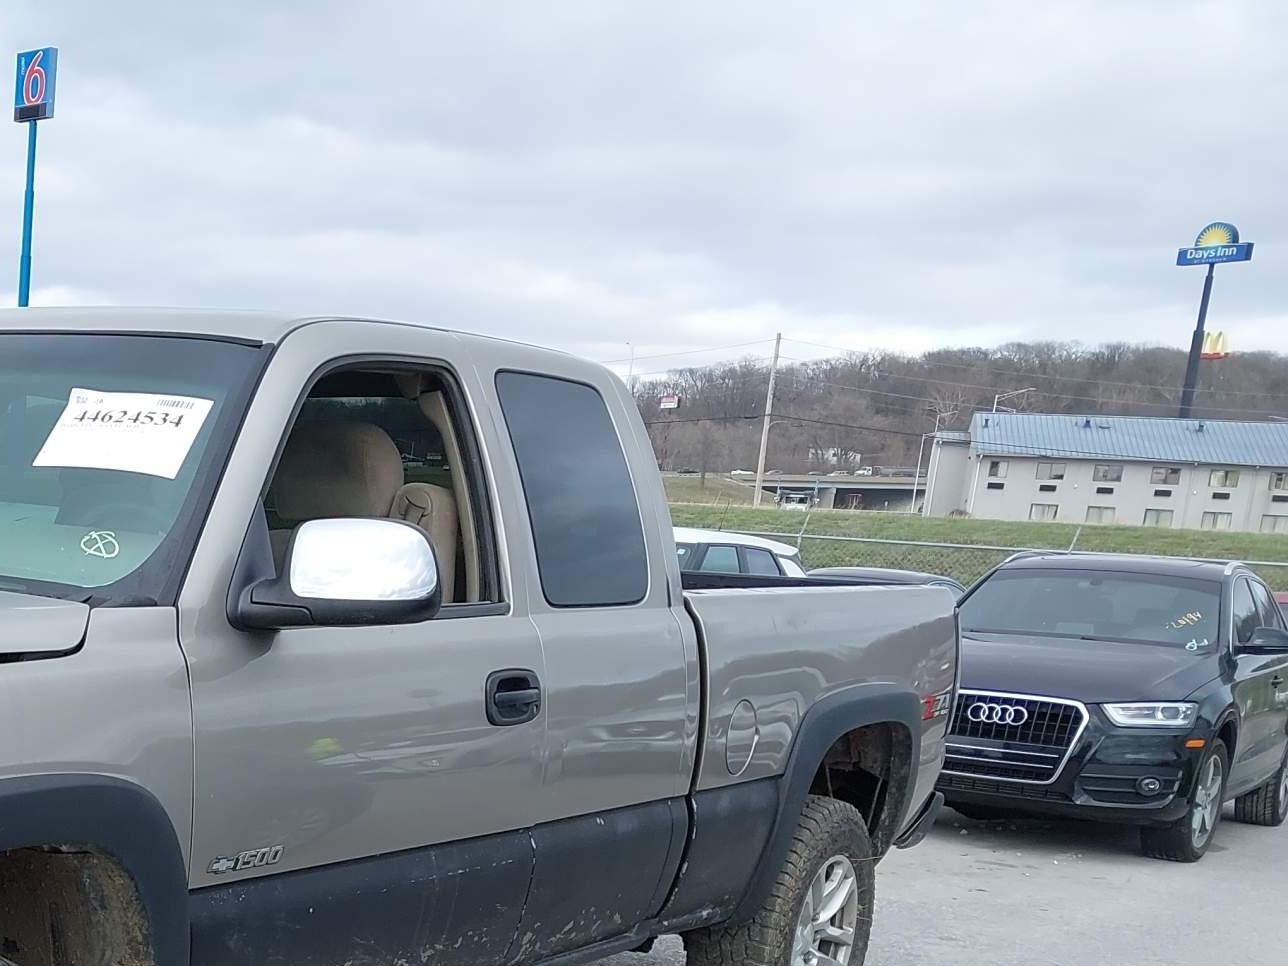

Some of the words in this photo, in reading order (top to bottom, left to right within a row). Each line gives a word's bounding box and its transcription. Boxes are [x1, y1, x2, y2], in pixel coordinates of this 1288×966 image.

[23, 50, 46, 105] 6
[1187, 249, 1216, 259] Days
[1216, 246, 1237, 256] Inn
[73, 409, 185, 428] 44624534
[235, 844, 285, 870] 1500
